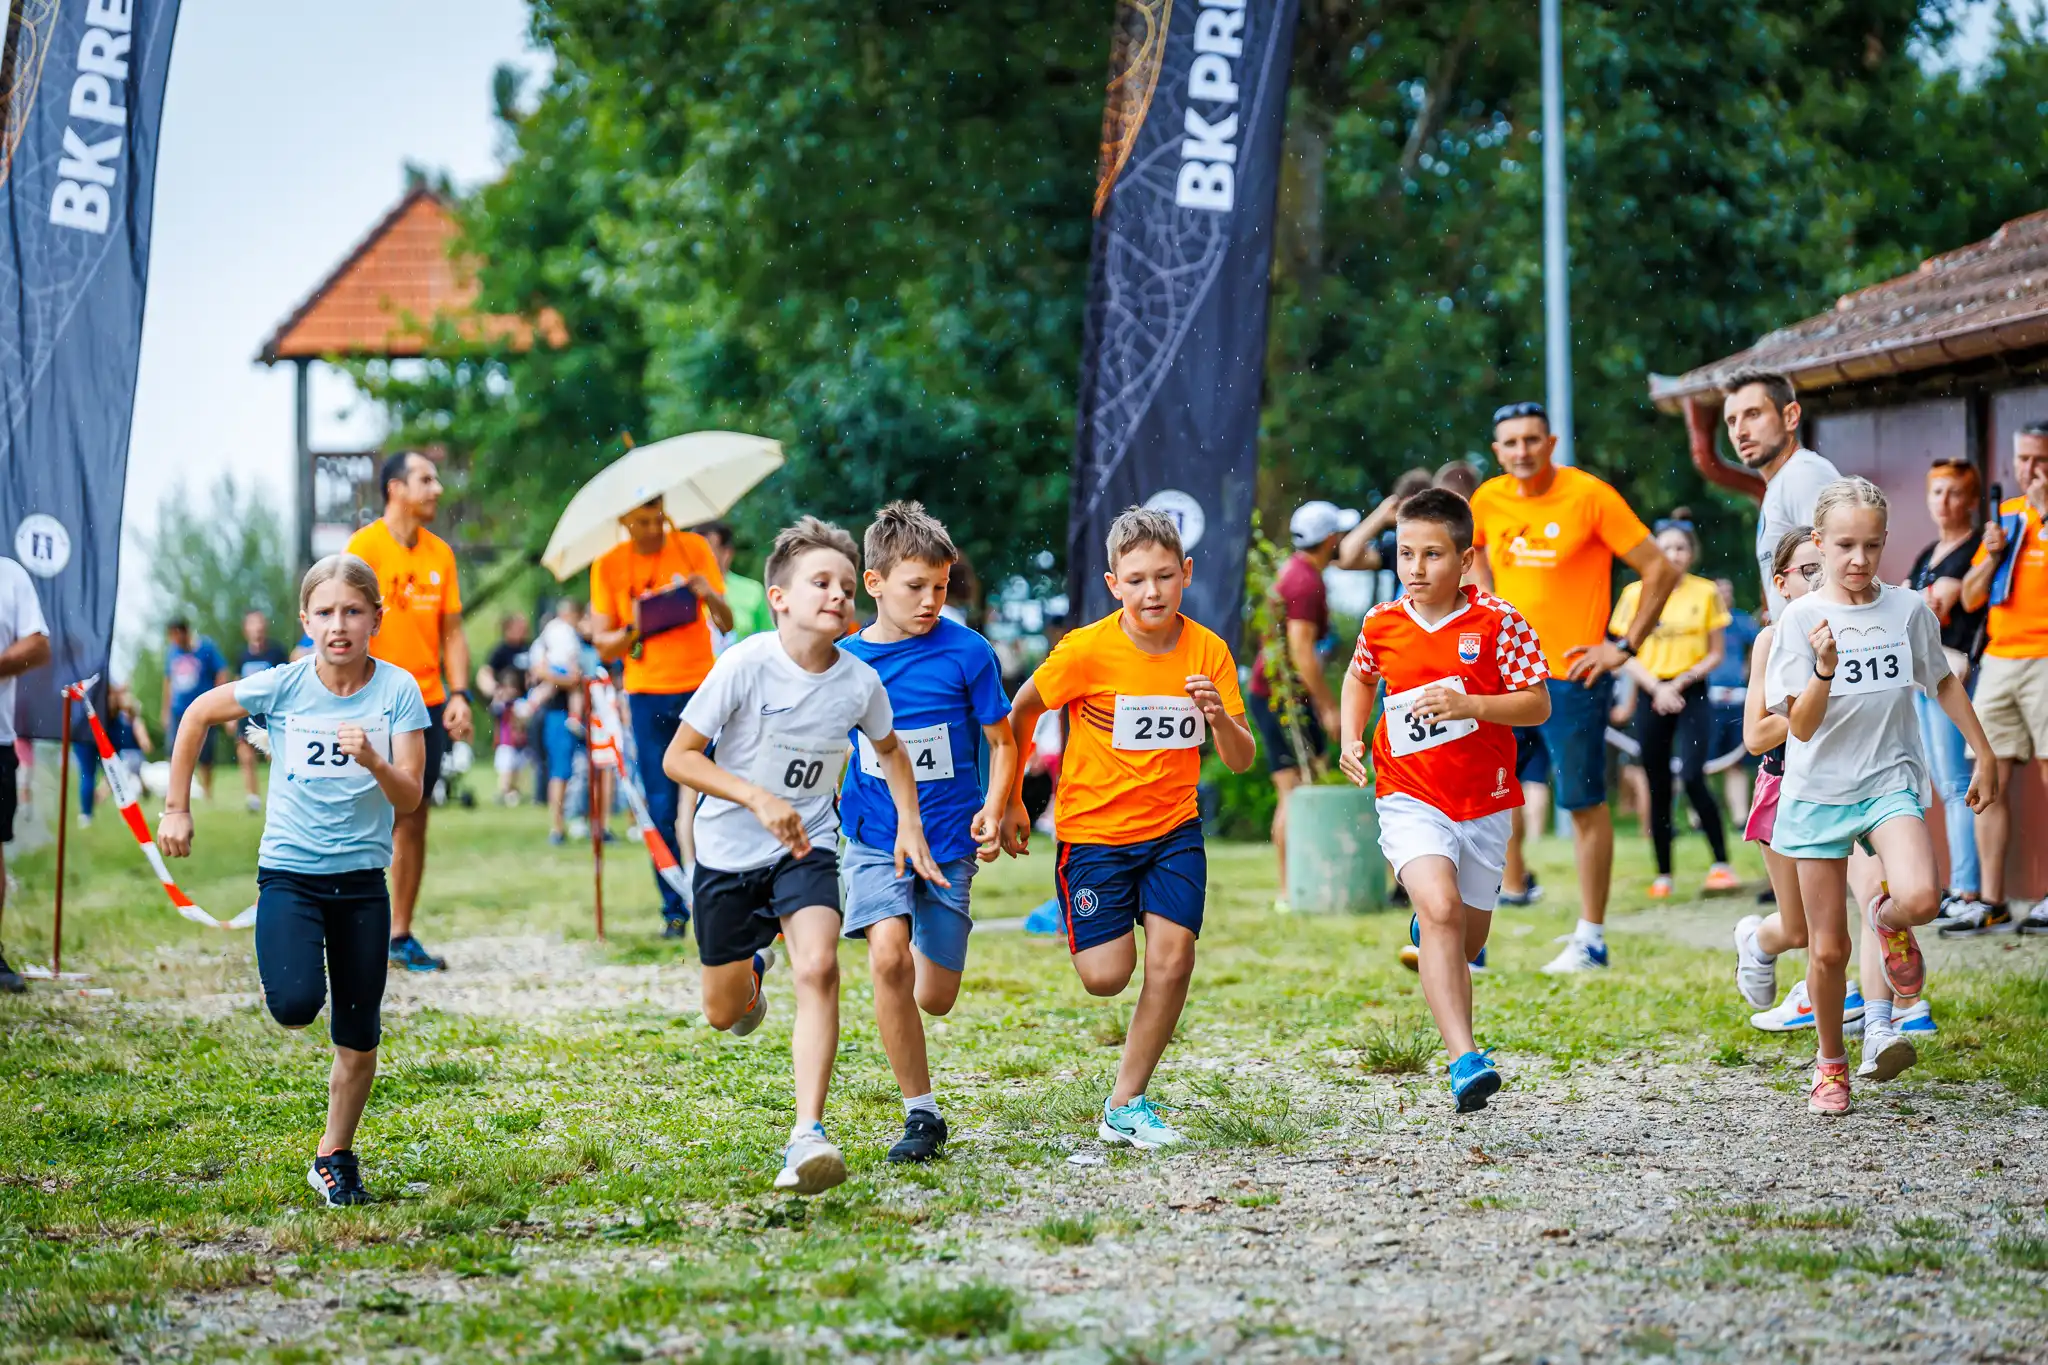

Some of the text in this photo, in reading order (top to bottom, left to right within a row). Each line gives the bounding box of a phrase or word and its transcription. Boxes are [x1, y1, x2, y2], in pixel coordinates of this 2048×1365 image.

[1174, 0, 1248, 213] BK PR
[49, 124, 124, 235] BK
[1844, 654, 1900, 684] 313
[1134, 715, 1197, 740] 250
[1404, 711, 1448, 742] 32
[306, 740, 363, 767] 25
[783, 758, 824, 789] 60
